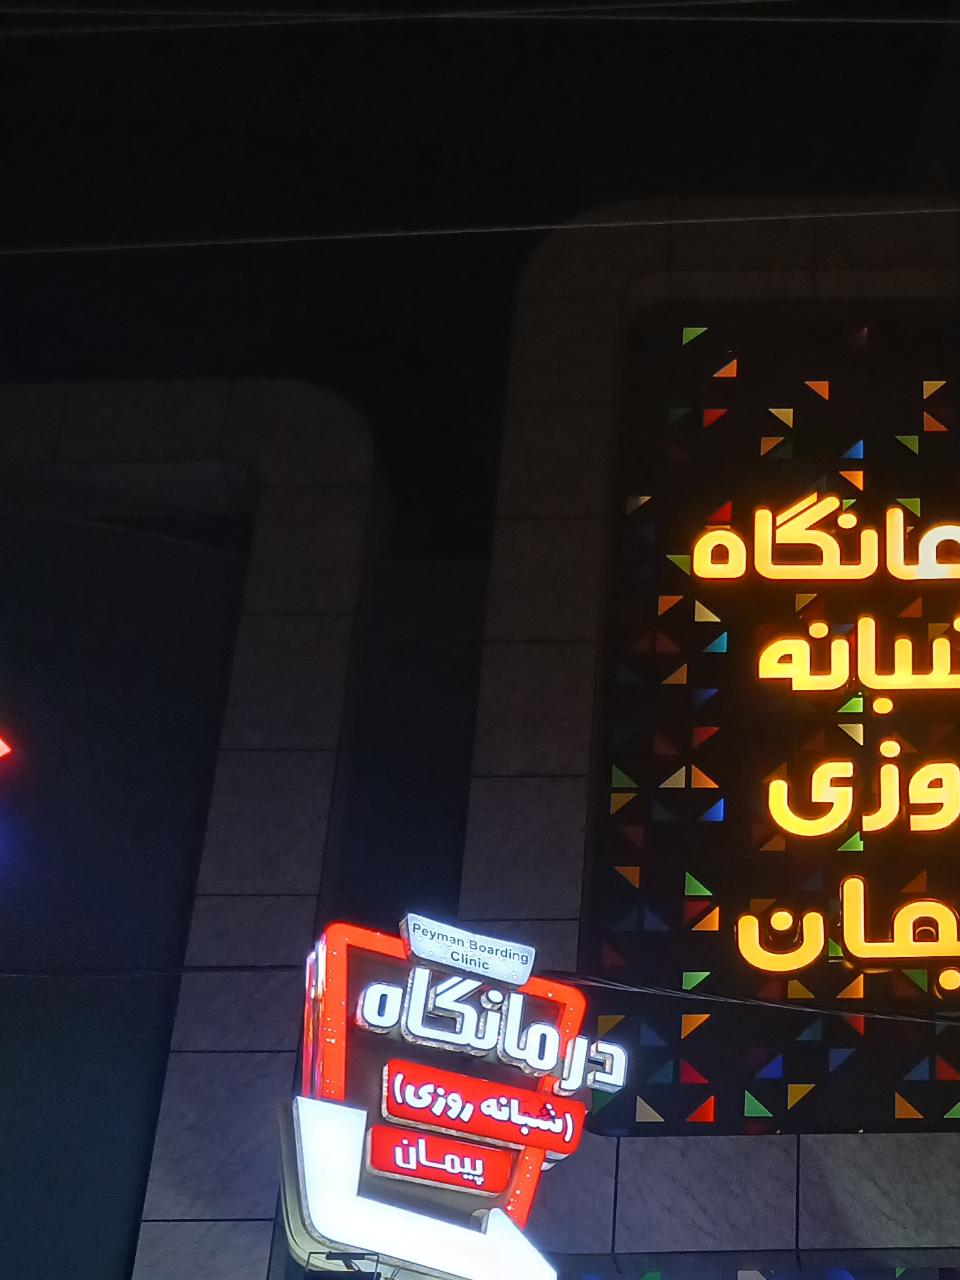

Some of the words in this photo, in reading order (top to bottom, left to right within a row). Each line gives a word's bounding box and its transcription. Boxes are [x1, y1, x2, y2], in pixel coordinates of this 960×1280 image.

[413, 923, 464, 947] Peyman
[469, 940, 529, 965] Boarding
[450, 951, 490, 970] Clinic
[358, 966, 628, 1096] درمانگاه
[394, 1138, 485, 1185] پیمان
